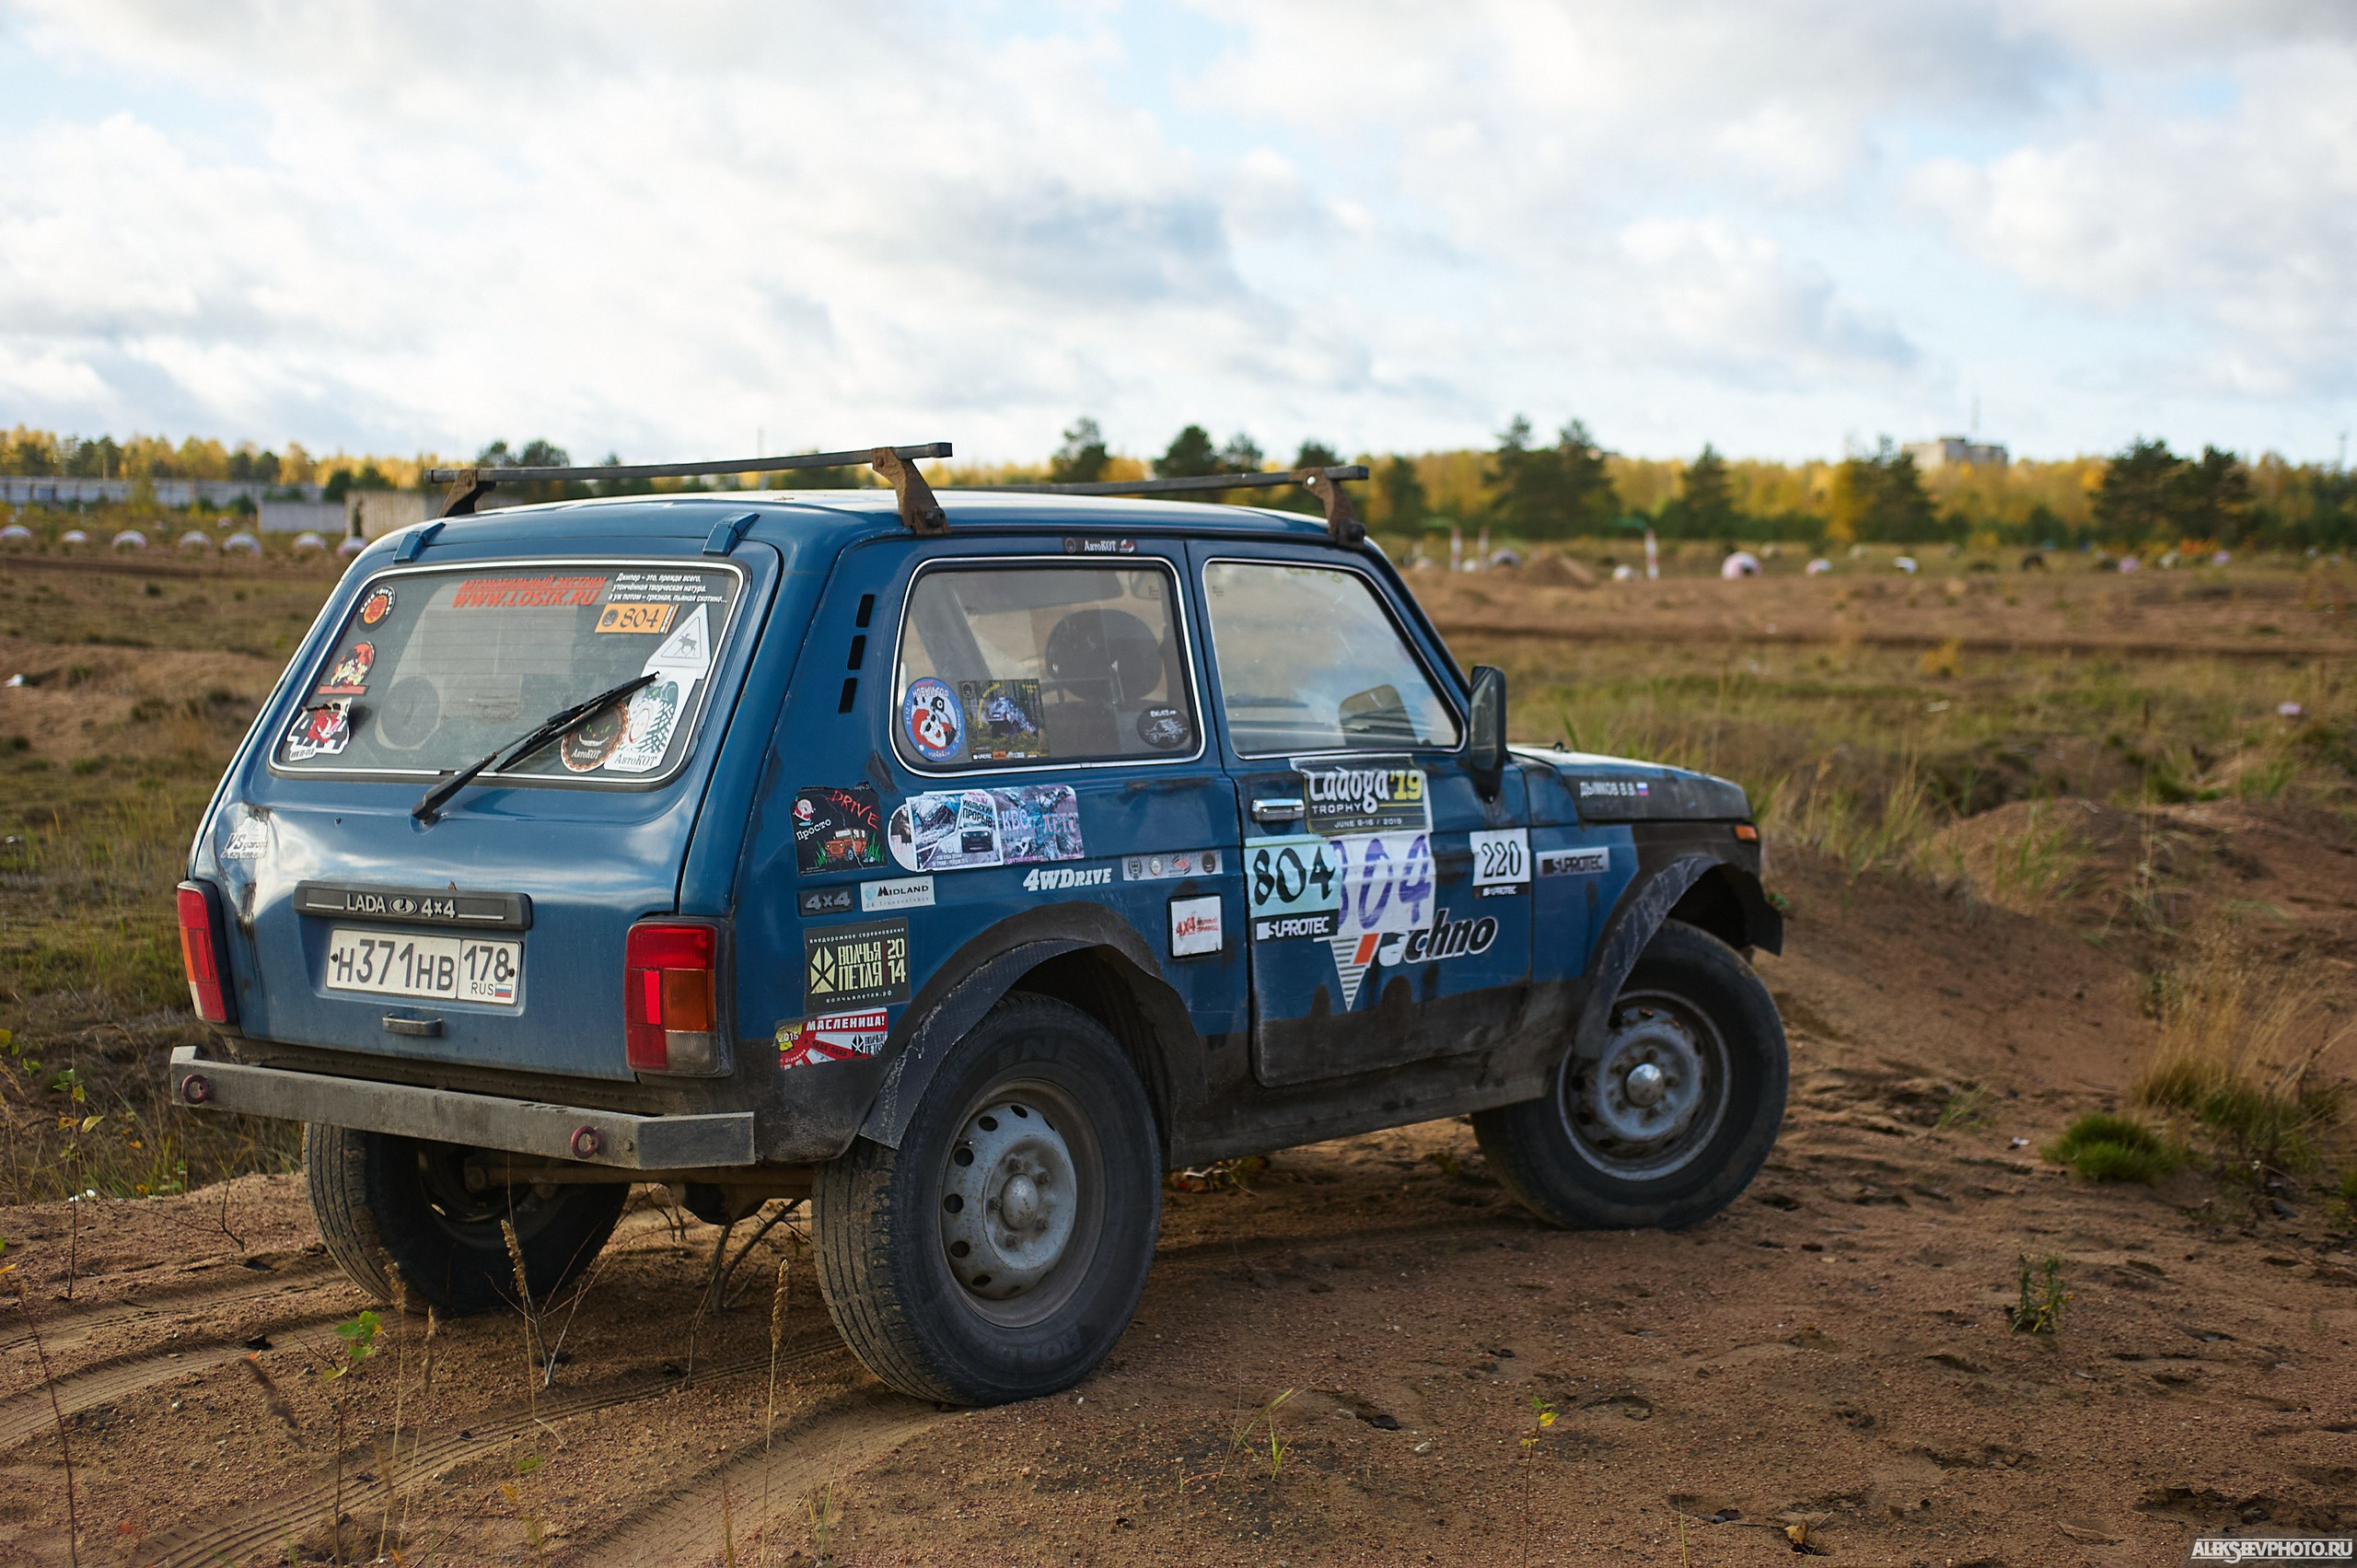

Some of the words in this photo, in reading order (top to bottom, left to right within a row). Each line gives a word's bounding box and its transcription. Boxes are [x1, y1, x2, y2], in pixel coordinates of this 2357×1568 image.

[1085, 540, 1116, 552] АвтоКОТ
[451, 590, 600, 609] WWW.LOSIK.RU
[620, 608, 660, 629] 804
[571, 748, 602, 760] АвтоКОТ
[614, 753, 657, 767] АвтоКОТ
[1301, 766, 1390, 814] Ladoga
[830, 790, 880, 830] DRIVE
[962, 807, 993, 828] ПРОРЫВ
[1311, 804, 1362, 815] TROPHY
[795, 819, 832, 841] Просто
[1001, 810, 1028, 830] КВС
[1334, 819, 1355, 829] JUNE
[1383, 818, 1402, 826] 2019
[226, 833, 247, 850] VS
[1480, 840, 1522, 879] 220
[1552, 854, 1604, 874] SUPROTEC
[1252, 845, 1336, 906] 804
[346, 893, 387, 913] LADA
[1268, 916, 1329, 938] SUPROTEC
[837, 941, 882, 967] ВОЛЧЬЯ
[886, 937, 906, 959] 20
[335, 938, 455, 992] Н371НВ
[463, 945, 509, 982] 178
[838, 960, 883, 992] ПЕТЛЯ
[887, 958, 907, 984] 14
[470, 981, 494, 996] RUS
[806, 1015, 886, 1031] МАСЛЕНИЦА!
[779, 1031, 799, 1043] 2015
